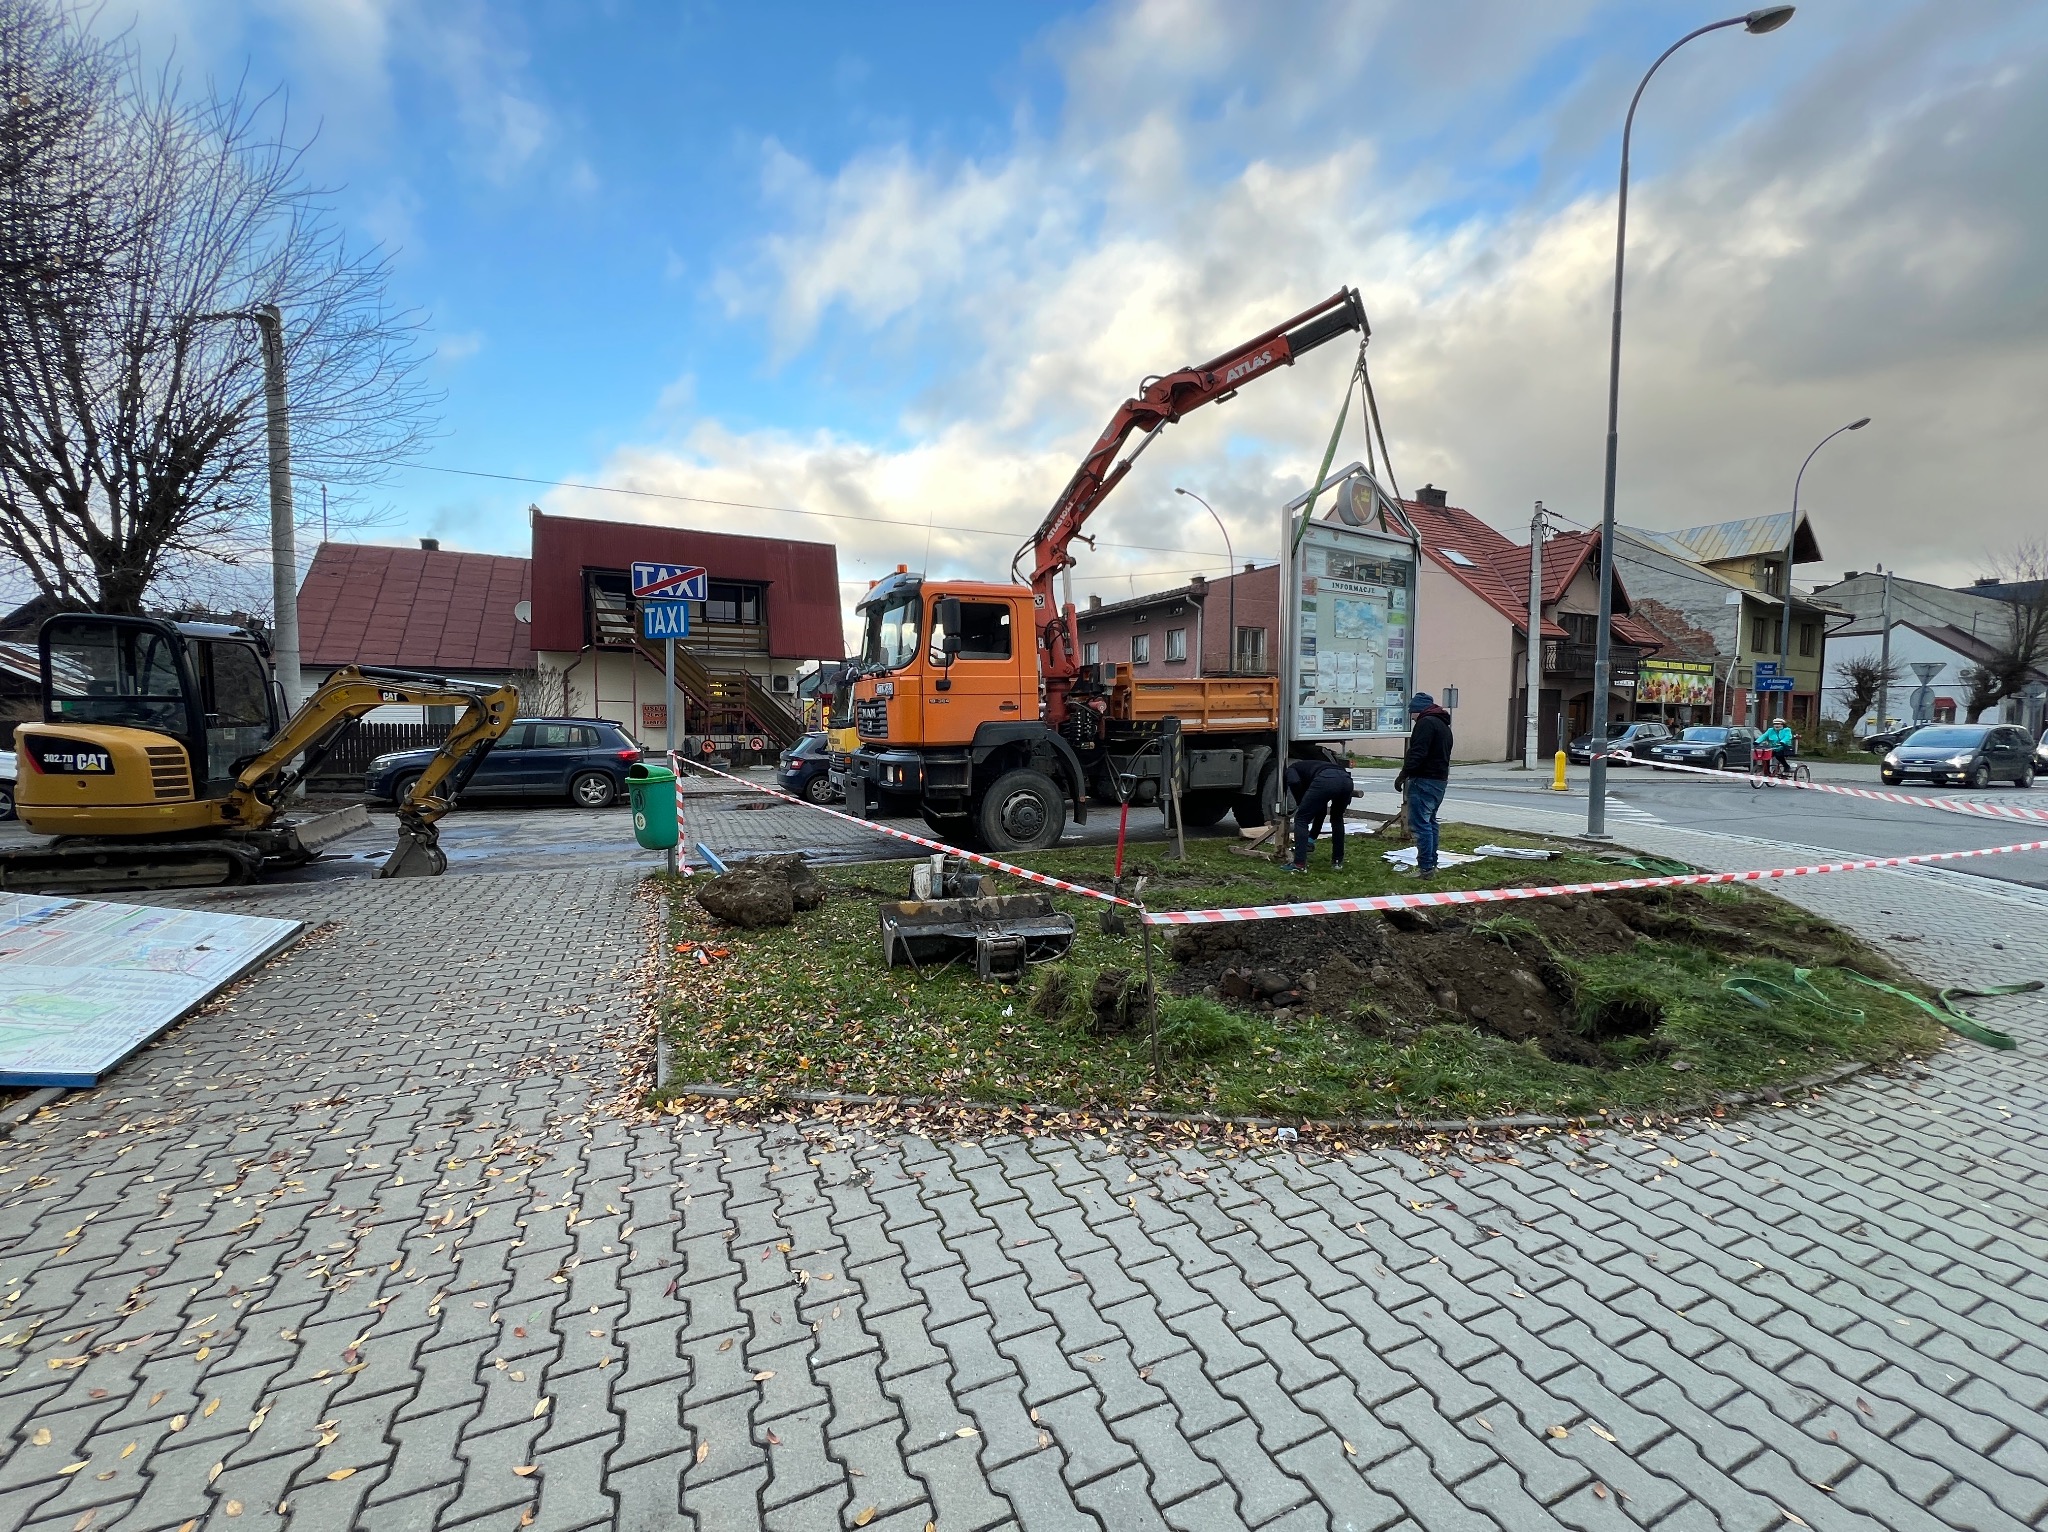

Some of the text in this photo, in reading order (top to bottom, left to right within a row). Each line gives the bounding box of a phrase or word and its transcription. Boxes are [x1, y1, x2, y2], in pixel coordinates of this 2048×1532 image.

[1226, 350, 1272, 384] ATLAS
[634, 565, 704, 598] TAXI
[1332, 582, 1375, 594] INFORMACJE
[645, 605, 685, 635] TAXI
[382, 692, 399, 702] CAT
[862, 708, 876, 718] MAN
[43, 753, 108, 771] 302.7D CAT
